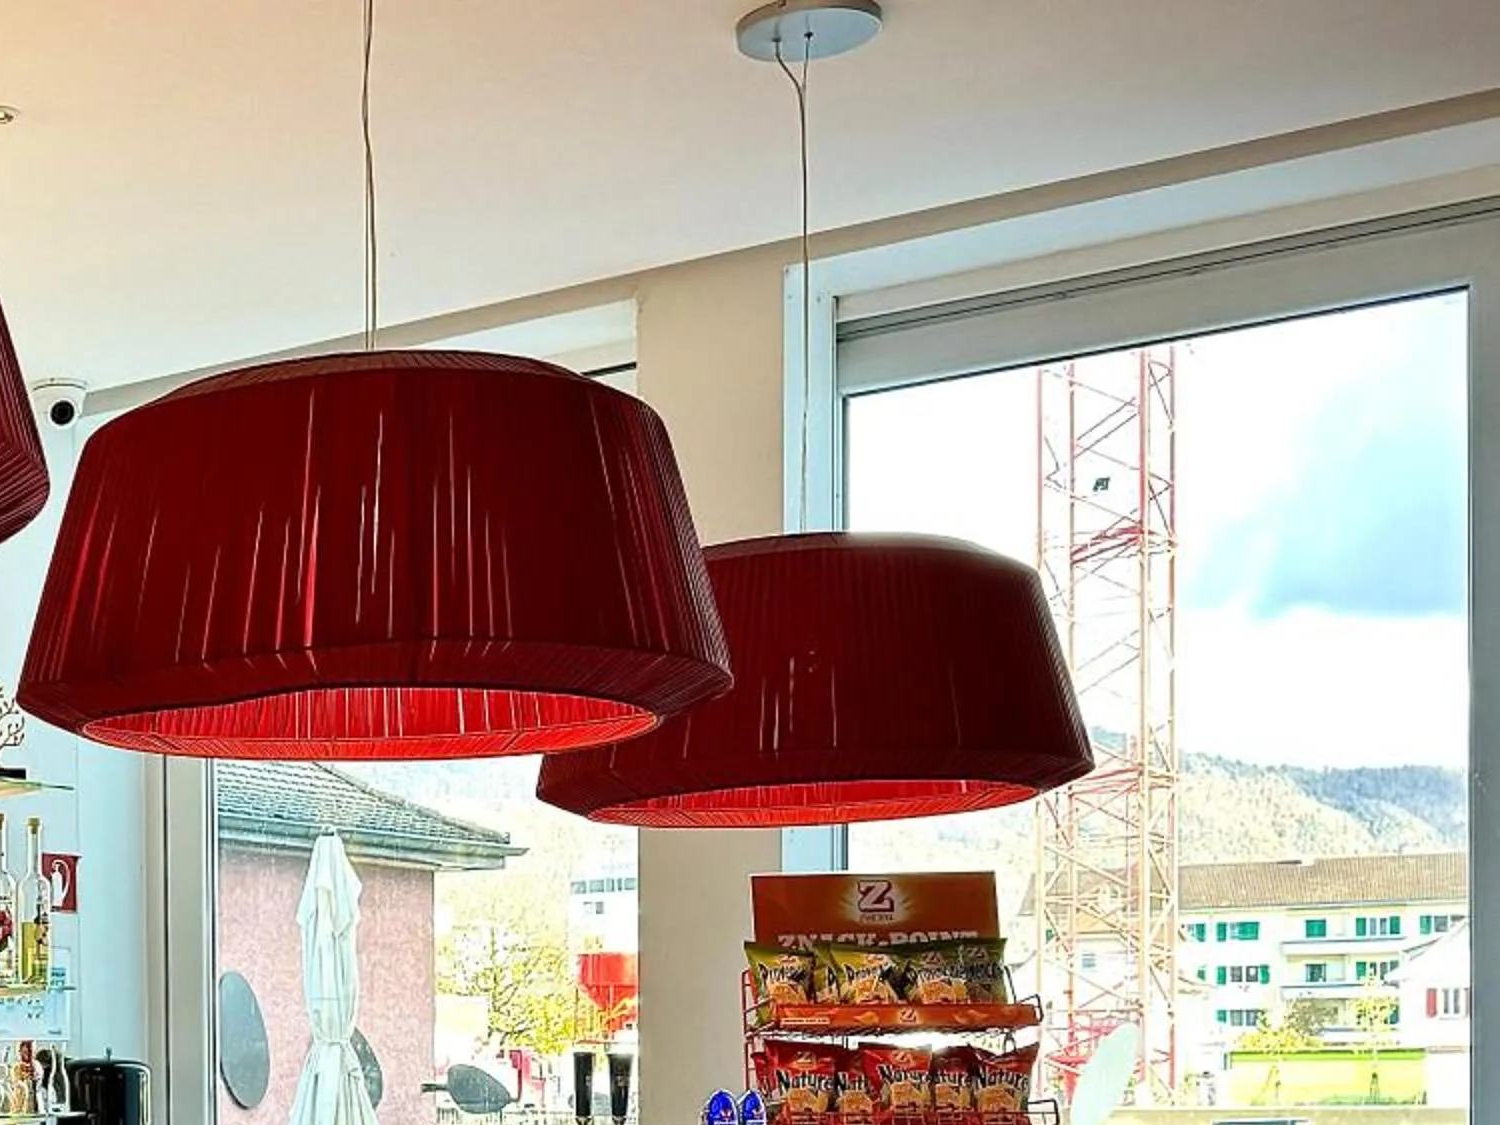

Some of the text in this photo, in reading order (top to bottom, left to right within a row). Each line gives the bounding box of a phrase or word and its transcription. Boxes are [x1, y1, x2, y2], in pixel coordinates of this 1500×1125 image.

[857, 879, 894, 912] Z
[776, 1069, 834, 1095] Nature
[974, 1065, 1030, 1092] Nature
